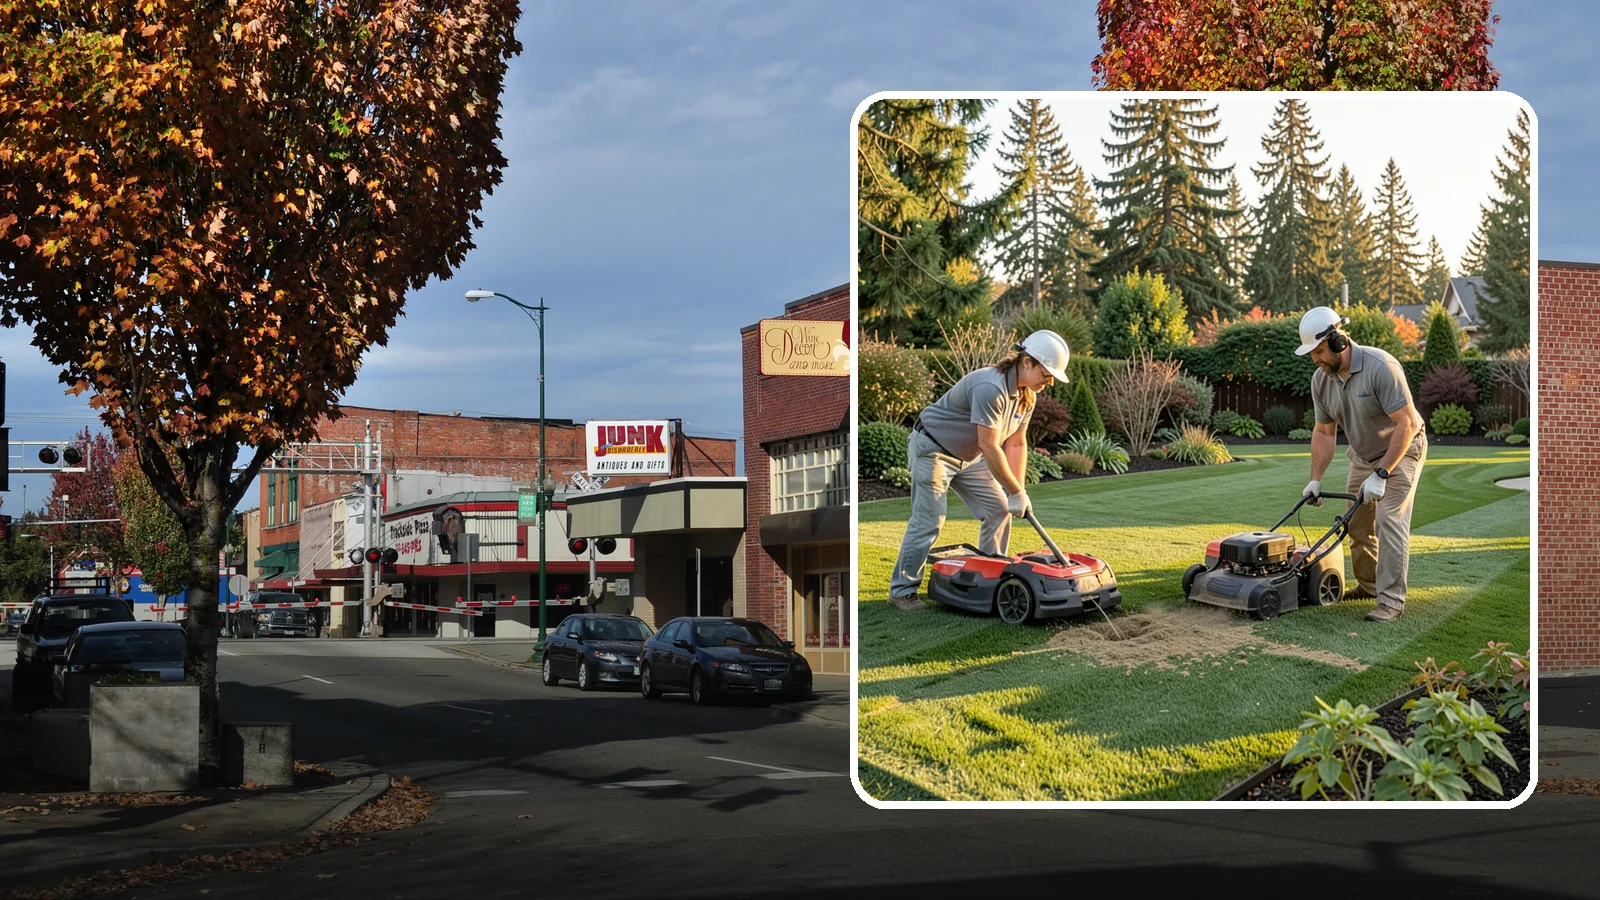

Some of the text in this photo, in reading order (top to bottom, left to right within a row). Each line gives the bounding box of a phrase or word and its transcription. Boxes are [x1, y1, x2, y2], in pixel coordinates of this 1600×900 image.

[595, 425, 665, 457] JUNK
[607, 446, 646, 454] DISORDERLY
[597, 460, 665, 470] ANTIQUES AND GIFTS
[573, 473, 587, 490] RAIL
[590, 477, 608, 491] SING
[414, 519, 429, 534] Pizza
